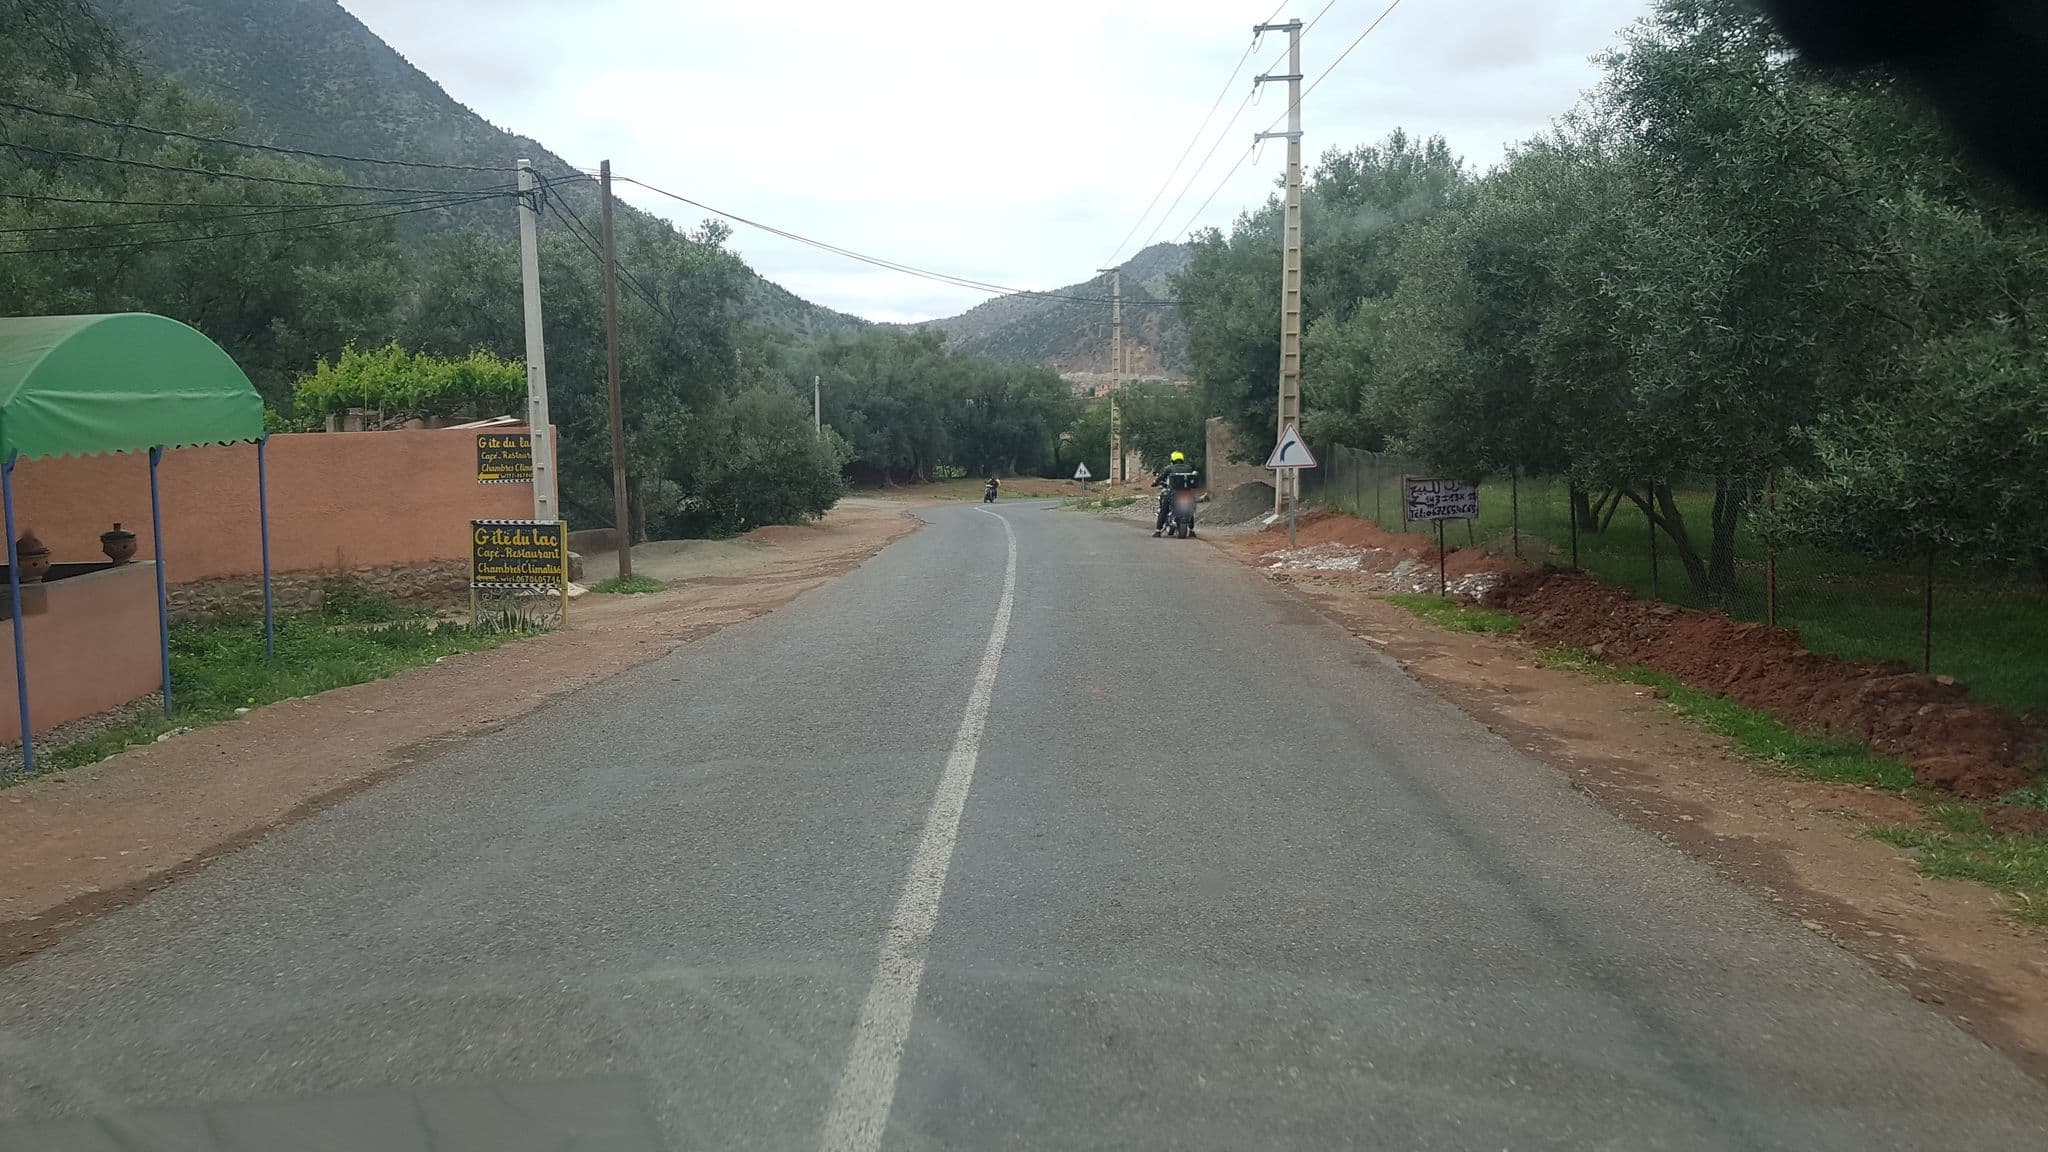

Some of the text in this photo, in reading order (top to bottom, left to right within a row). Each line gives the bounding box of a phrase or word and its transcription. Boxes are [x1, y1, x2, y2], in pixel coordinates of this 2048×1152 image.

[503, 437, 515, 448] du
[520, 437, 531, 448] la
[512, 528, 530, 546] du
[533, 528, 559, 547] lac
[478, 562, 521, 574] Chambres
